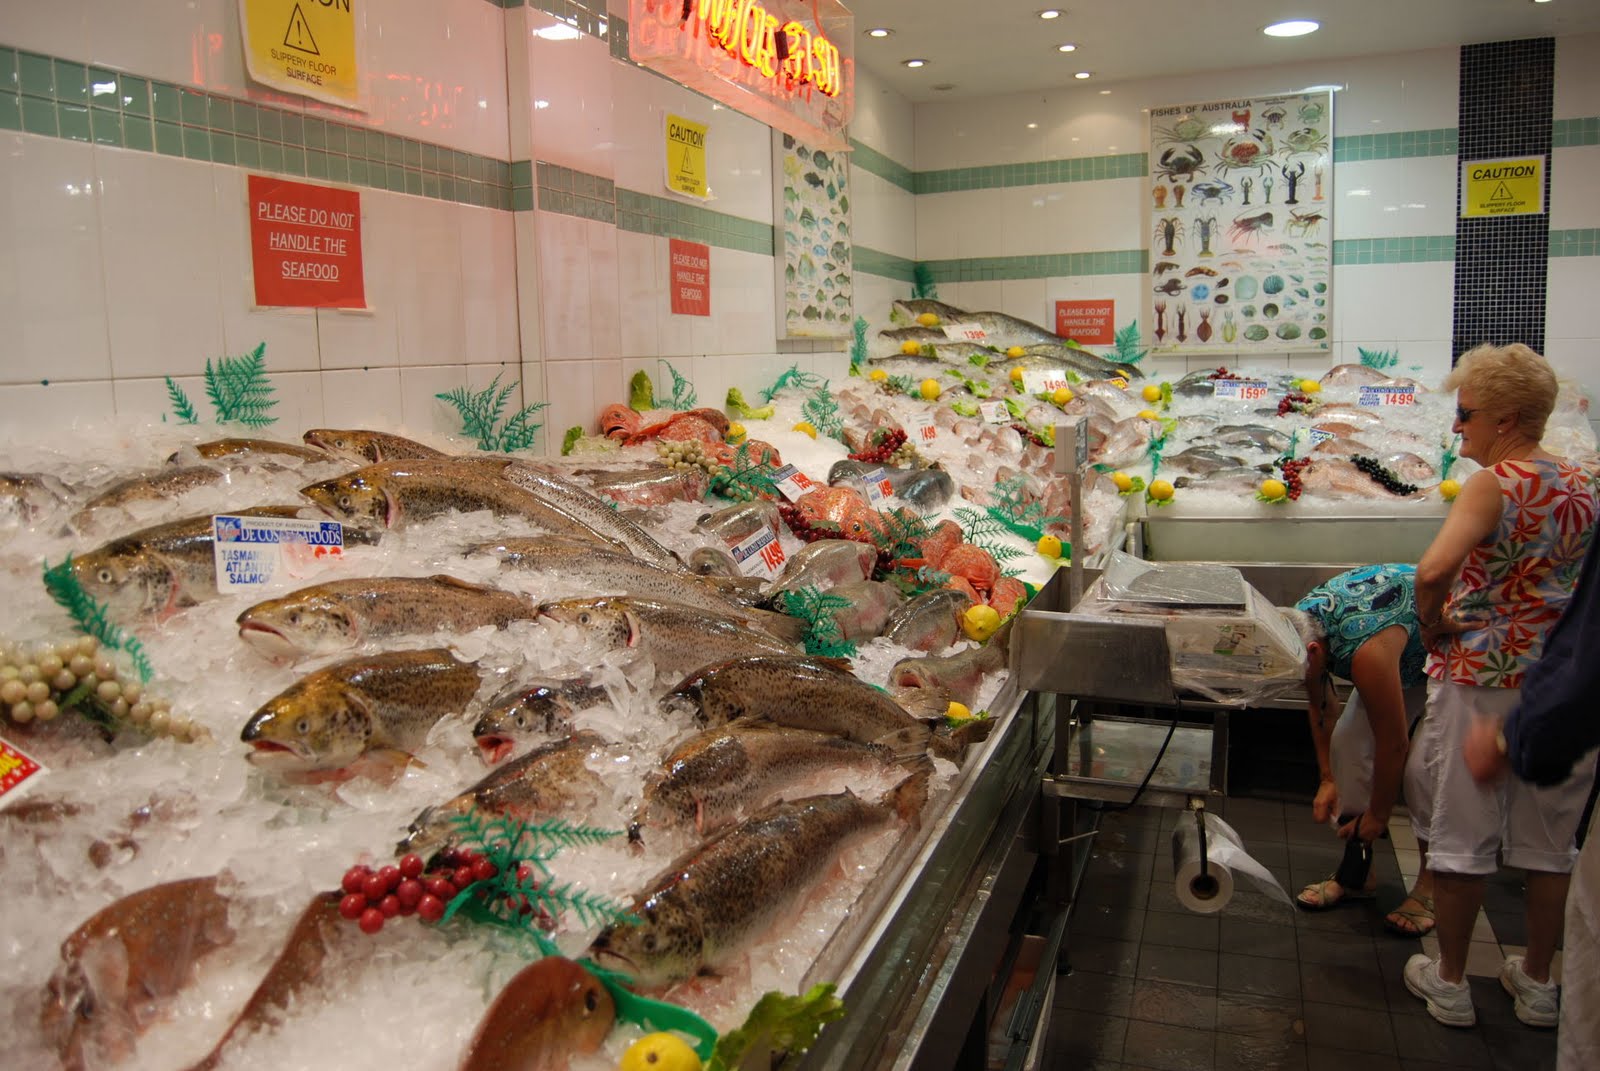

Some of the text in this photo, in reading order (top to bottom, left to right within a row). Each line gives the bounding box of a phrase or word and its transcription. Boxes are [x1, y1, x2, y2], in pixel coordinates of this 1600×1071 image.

[271, 49, 337, 76] SLIPPERY FLOOR
[286, 66, 323, 86] SURFACE
[1151, 107, 1181, 118] FISHES
[1186, 106, 1198, 114] OF
[1202, 100, 1252, 112] AUSTRALIA
[669, 123, 704, 147] CAUTION
[1473, 166, 1535, 180] CAUTION
[1480, 201, 1506, 209] SLIPPERY
[258, 201, 355, 229] PLEASE DO NOT
[270, 231, 347, 254] HANDLE THE
[673, 252, 690, 266] PLEASE
[691, 255, 699, 267] DO
[281, 260, 339, 280] SEAFOOD
[676, 270, 705, 284] HANDLE THE
[681, 287, 702, 299] SEAFOOD
[1059, 307, 1110, 316] PLEASE DO NOT
[1063, 317, 1105, 326] HANDLE THE
[1069, 328, 1100, 336] SEAFOOD
[1385, 393, 1413, 406] 1499
[245, 520, 276, 528] PRODUCT
[285, 521, 316, 530] AUSTRALIA
[241, 528, 257, 542] DE
[760, 538, 786, 572] 1499
